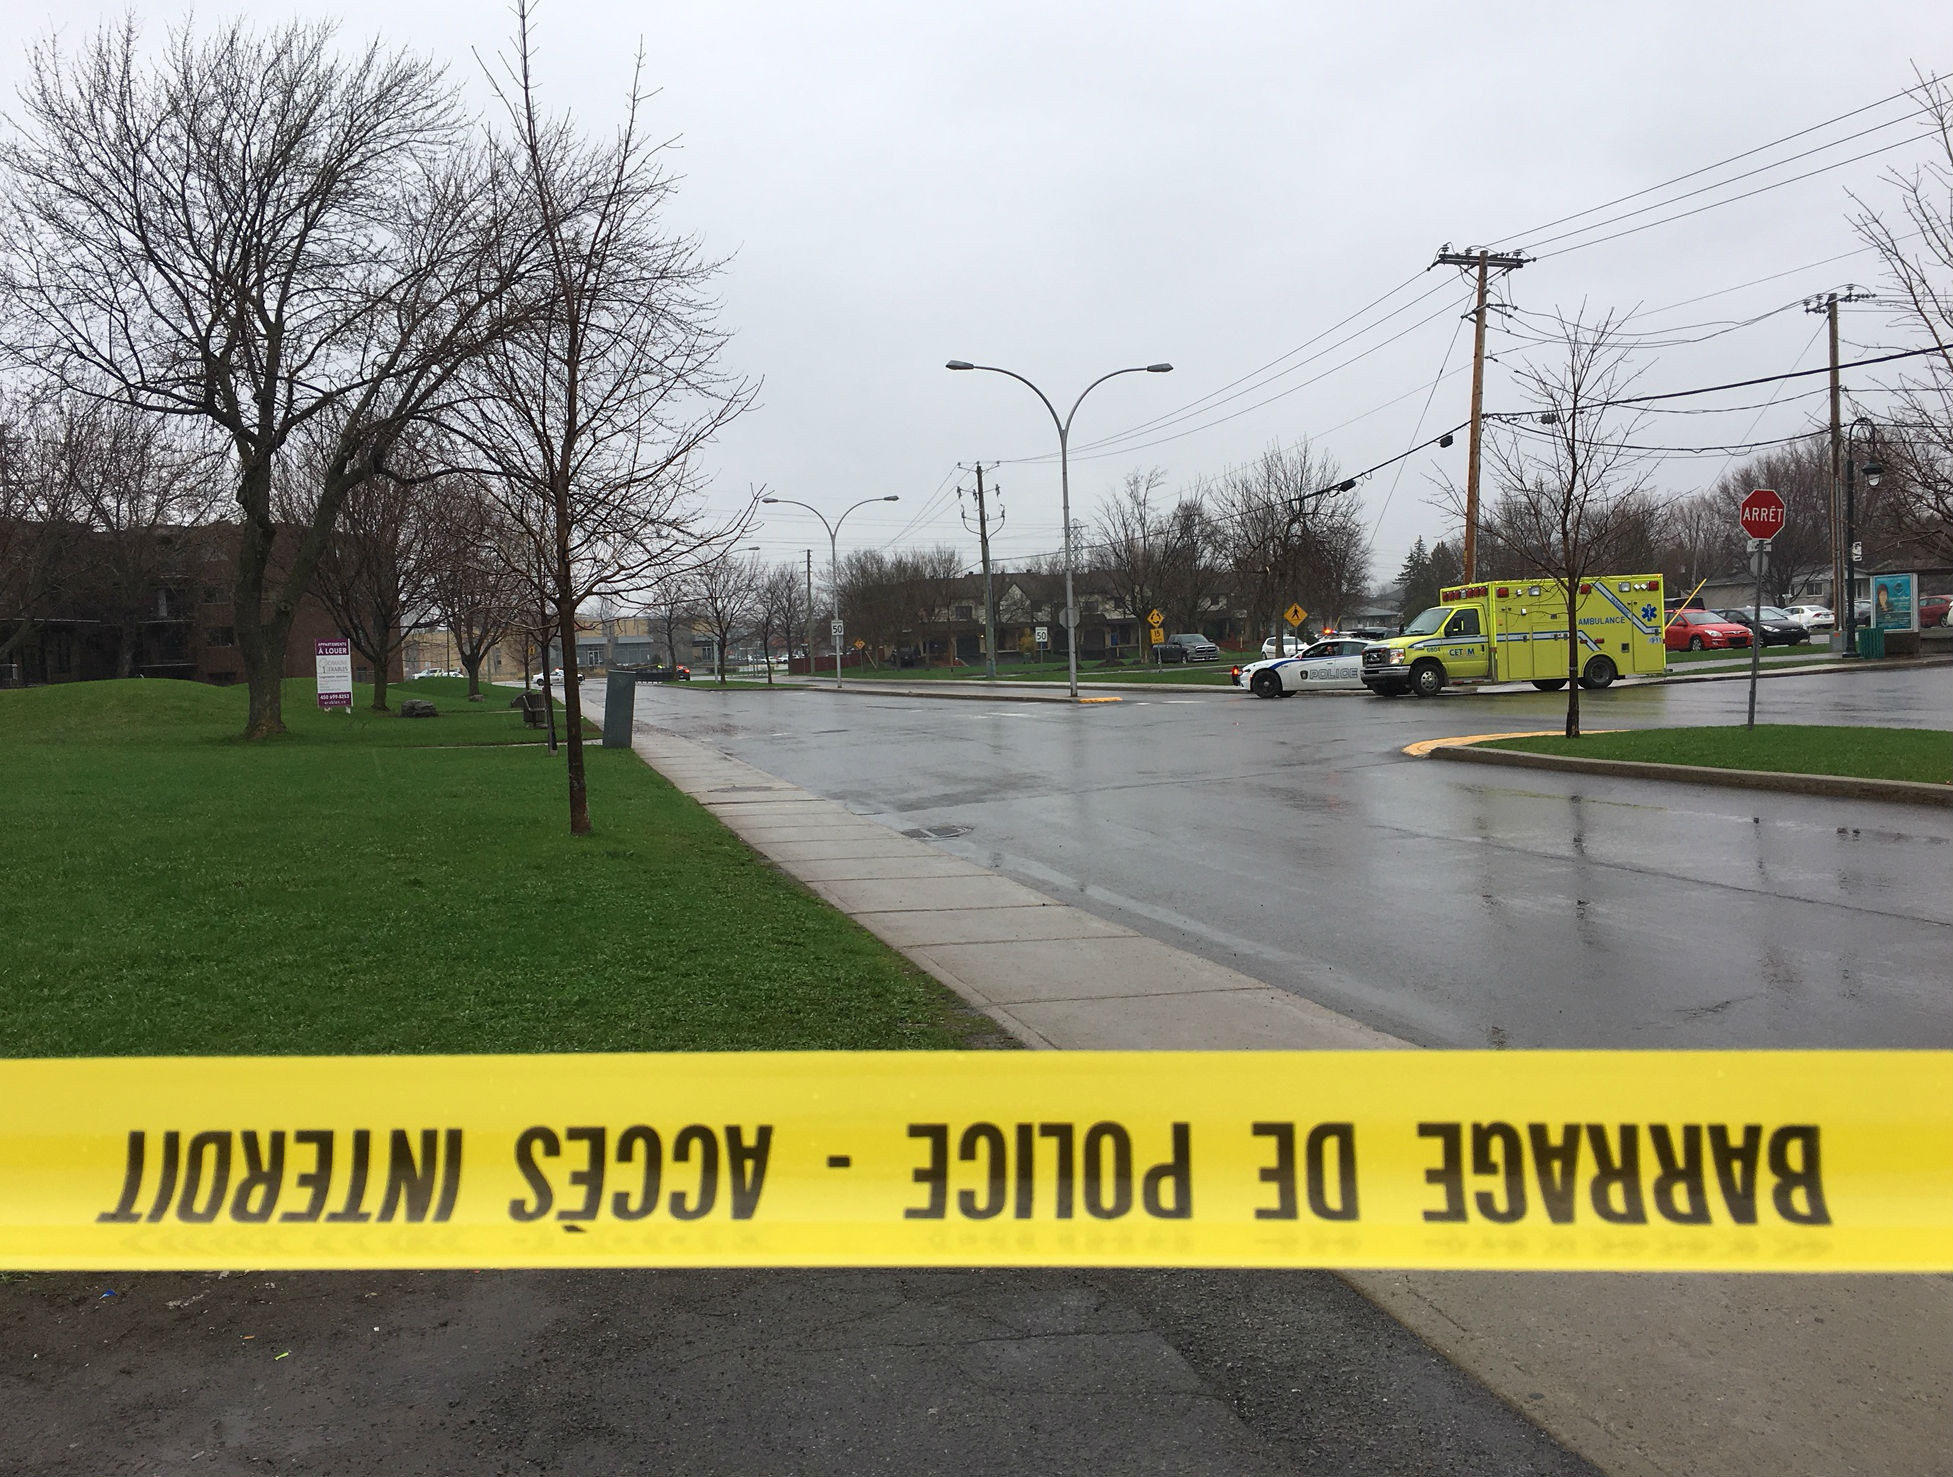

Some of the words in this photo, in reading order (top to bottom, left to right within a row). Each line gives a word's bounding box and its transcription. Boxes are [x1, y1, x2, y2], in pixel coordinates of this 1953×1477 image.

[1742, 506, 1783, 522] ARRÊT
[1578, 617, 1625, 625] AMBULANCE
[833, 625, 842, 634] 50
[1037, 632, 1046, 641] 50
[1309, 668, 1358, 680] POLICE
[827, 1156, 850, 1168] -
[99, 1129, 462, 1222] INTERDIT
[510, 1125, 773, 1232] ACCÈS
[905, 1122, 1191, 1219] POLICE
[1252, 1123, 1358, 1221] DE
[1418, 1122, 1831, 1225] BARRAGE
